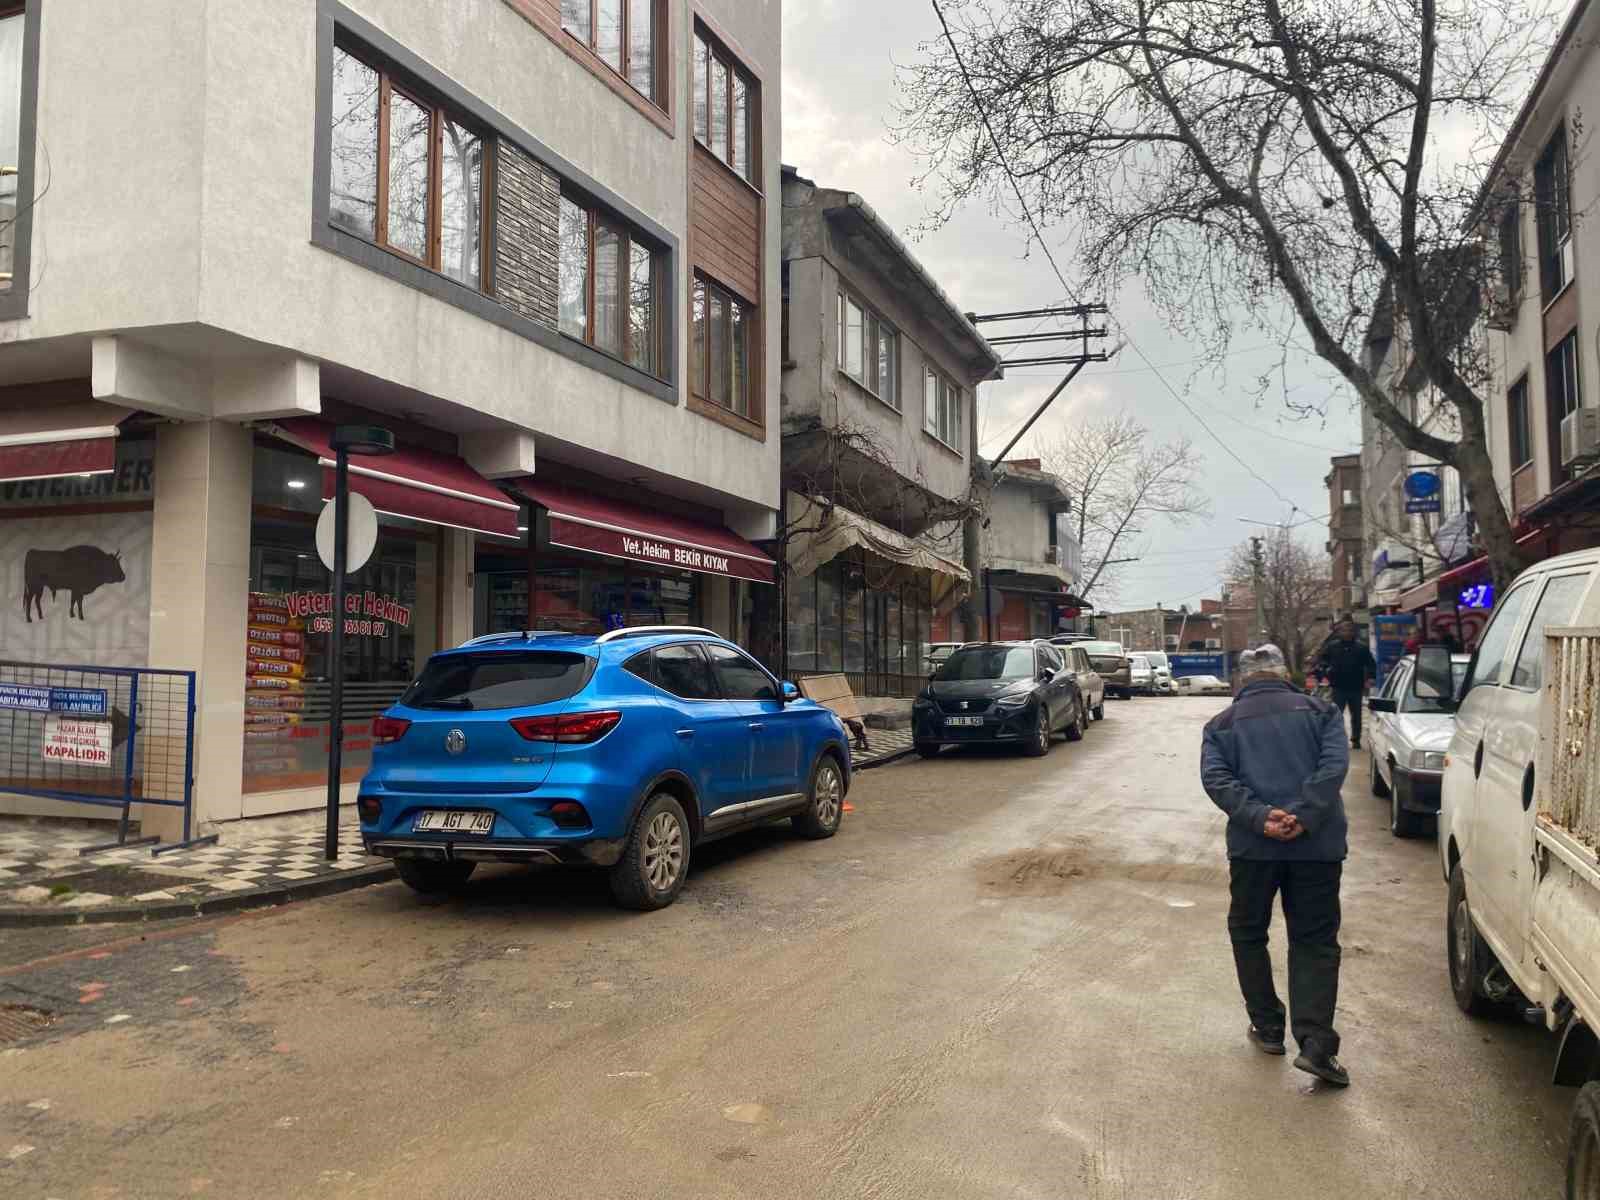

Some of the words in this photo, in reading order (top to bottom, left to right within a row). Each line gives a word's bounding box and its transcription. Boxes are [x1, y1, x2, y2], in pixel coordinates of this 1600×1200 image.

[622, 537, 641, 555] Vet.
[642, 541, 670, 560] Hekim
[674, 549, 701, 567] BEKİR
[703, 553, 729, 572] KIYAK
[364, 590, 409, 627] Hekim
[442, 812, 465, 828] AGT
[470, 813, 492, 829] 740
